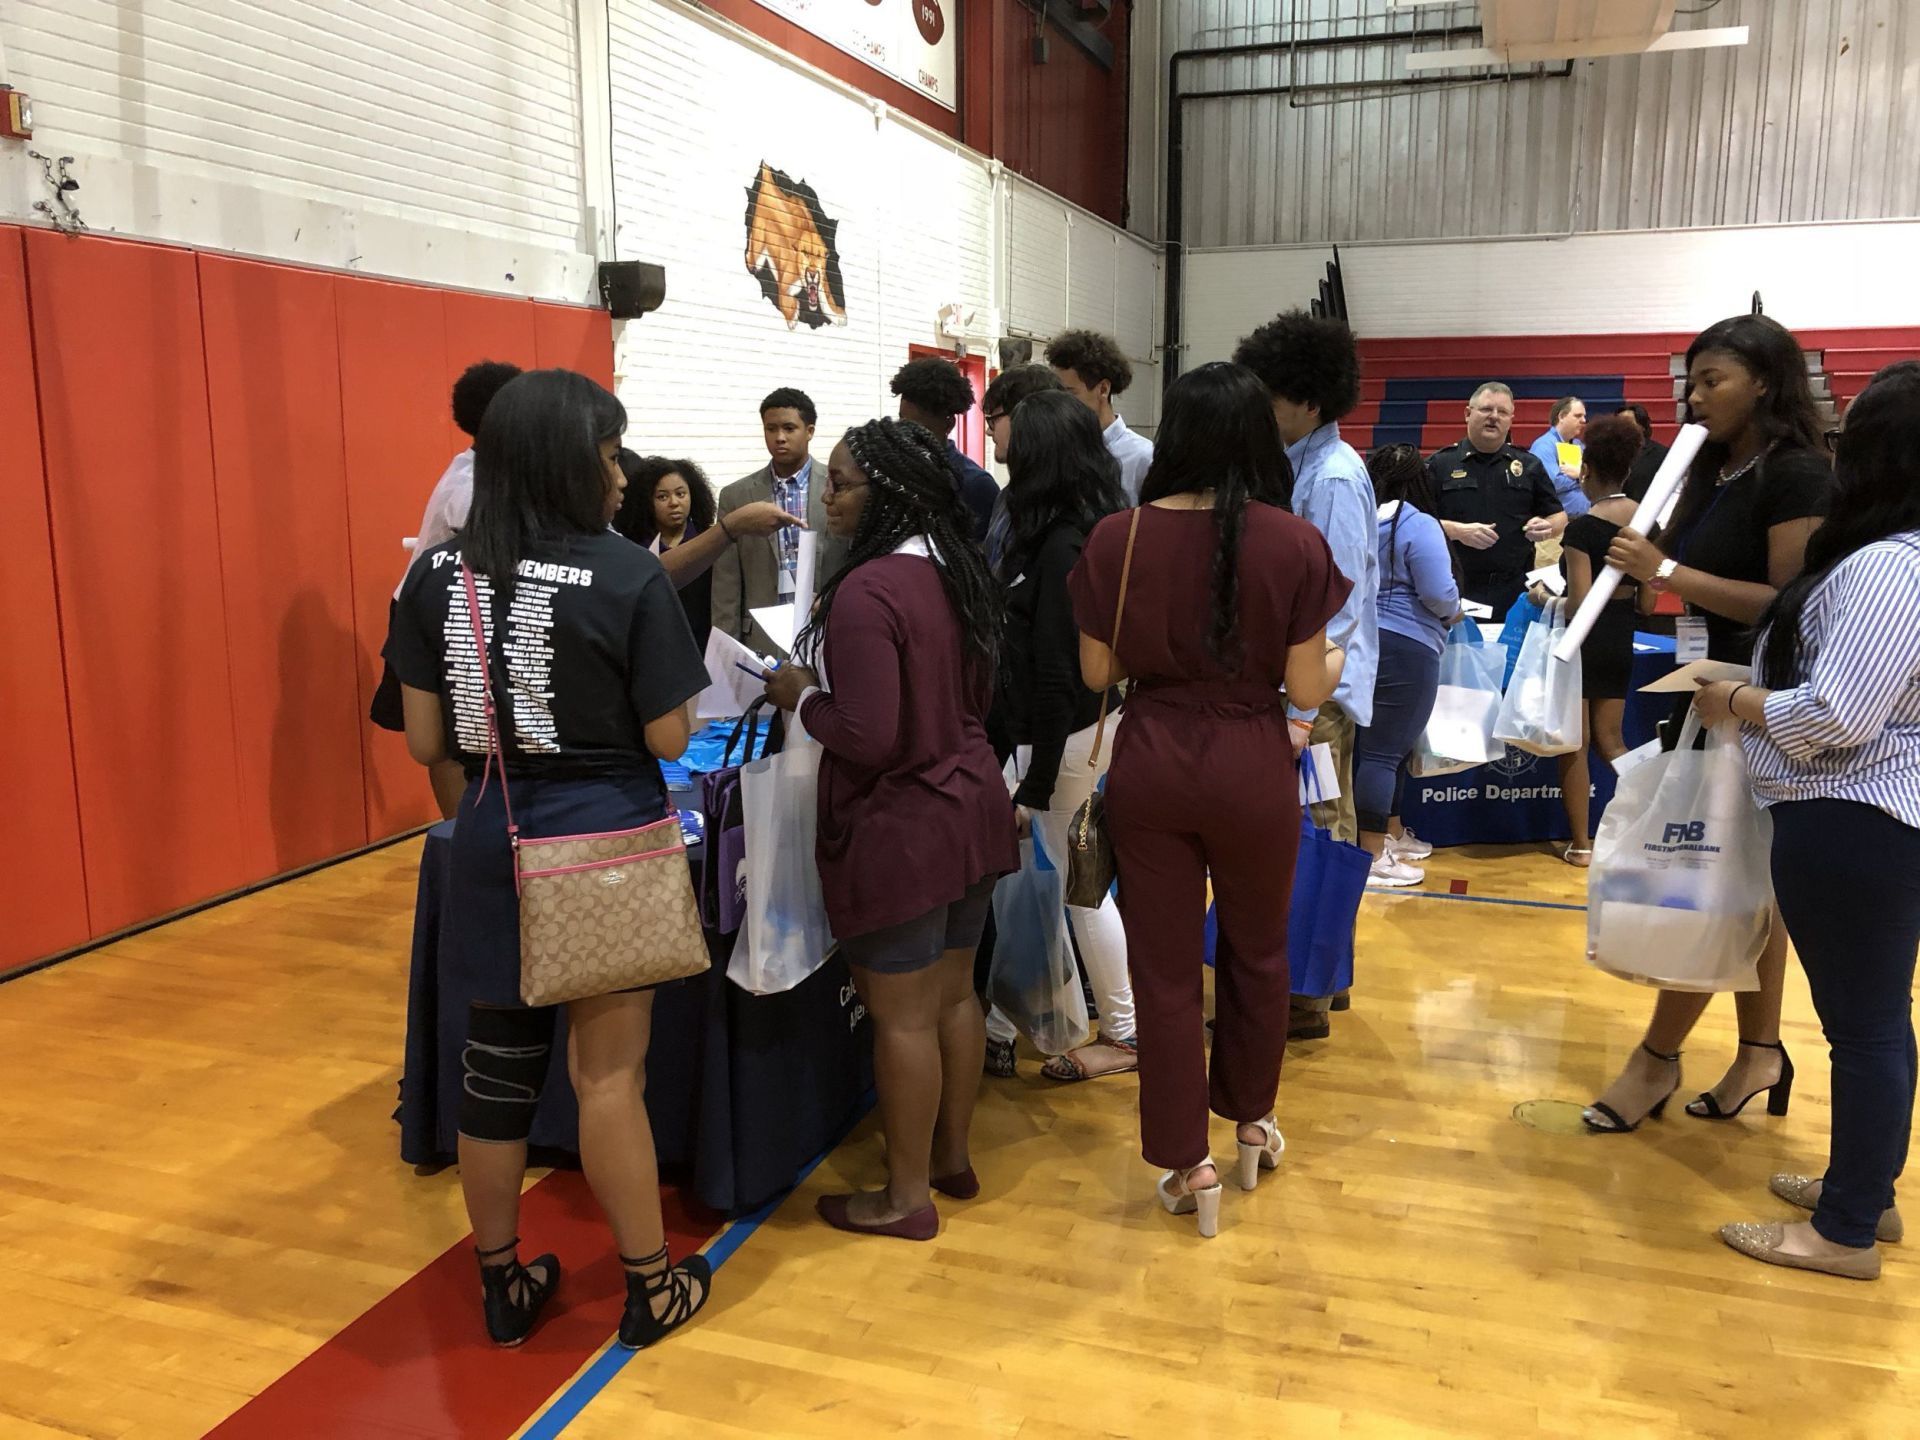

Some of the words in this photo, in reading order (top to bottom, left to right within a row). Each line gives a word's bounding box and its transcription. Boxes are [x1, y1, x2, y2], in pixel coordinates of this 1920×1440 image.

[921, 4, 935, 27] 1991
[431, 550, 463, 569] 17-1
[1421, 786, 1478, 804] Police
[1485, 784, 1596, 803] Departmt
[1662, 821, 1706, 844] FNB
